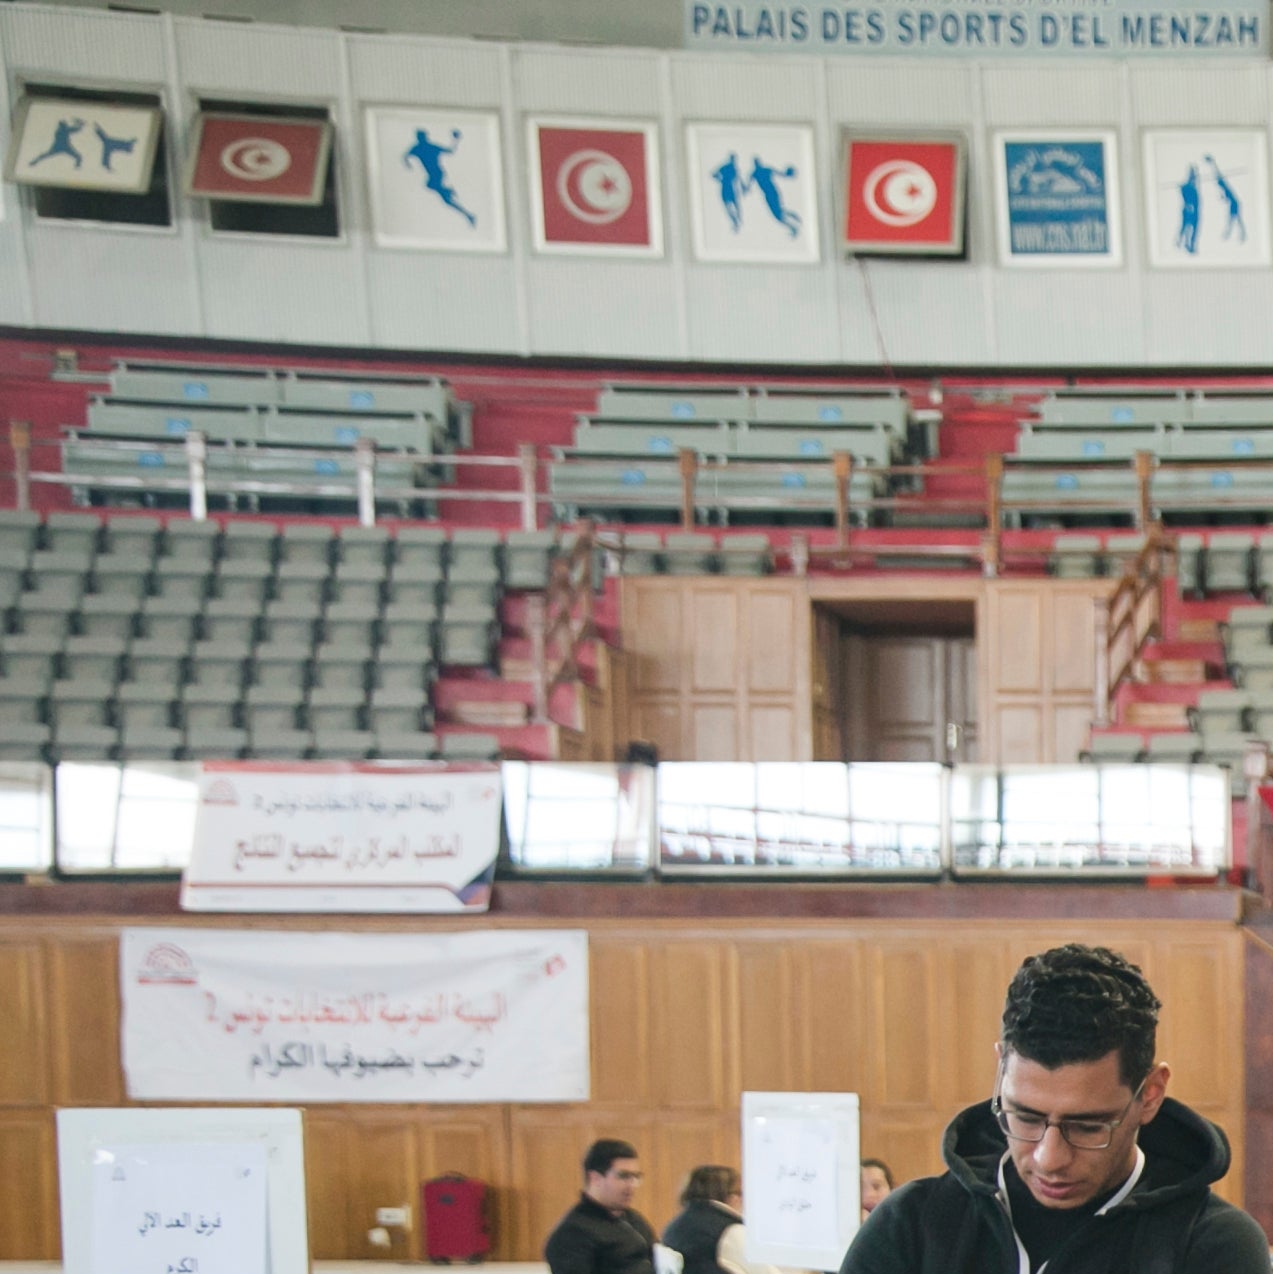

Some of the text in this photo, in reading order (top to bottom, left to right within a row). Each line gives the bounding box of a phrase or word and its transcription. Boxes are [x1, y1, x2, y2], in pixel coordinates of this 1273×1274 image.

[693, 6, 809, 41] PALAIS
[822, 11, 885, 43] DES
[898, 13, 1027, 46] SPORTS
[1122, 16, 1259, 46] MENZAH
